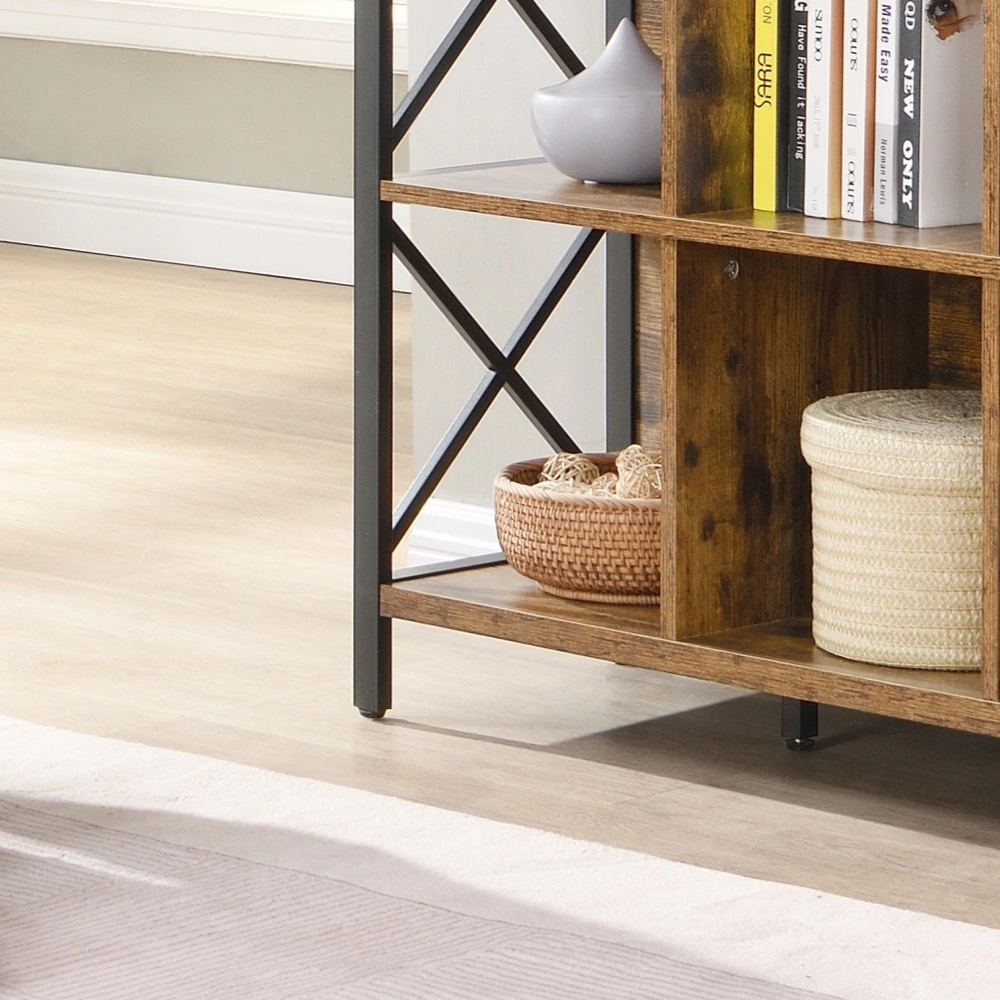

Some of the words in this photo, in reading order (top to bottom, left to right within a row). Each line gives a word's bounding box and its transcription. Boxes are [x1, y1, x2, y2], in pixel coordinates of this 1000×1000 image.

[881, 4, 891, 43] Made
[754, 52, 773, 108] SARA
[797, 56, 807, 89] Found
[878, 50, 891, 82] Easy
[797, 96, 806, 108] it
[903, 58, 915, 119] NEW
[795, 116, 807, 160] lacking
[902, 139, 914, 210] ONLY
